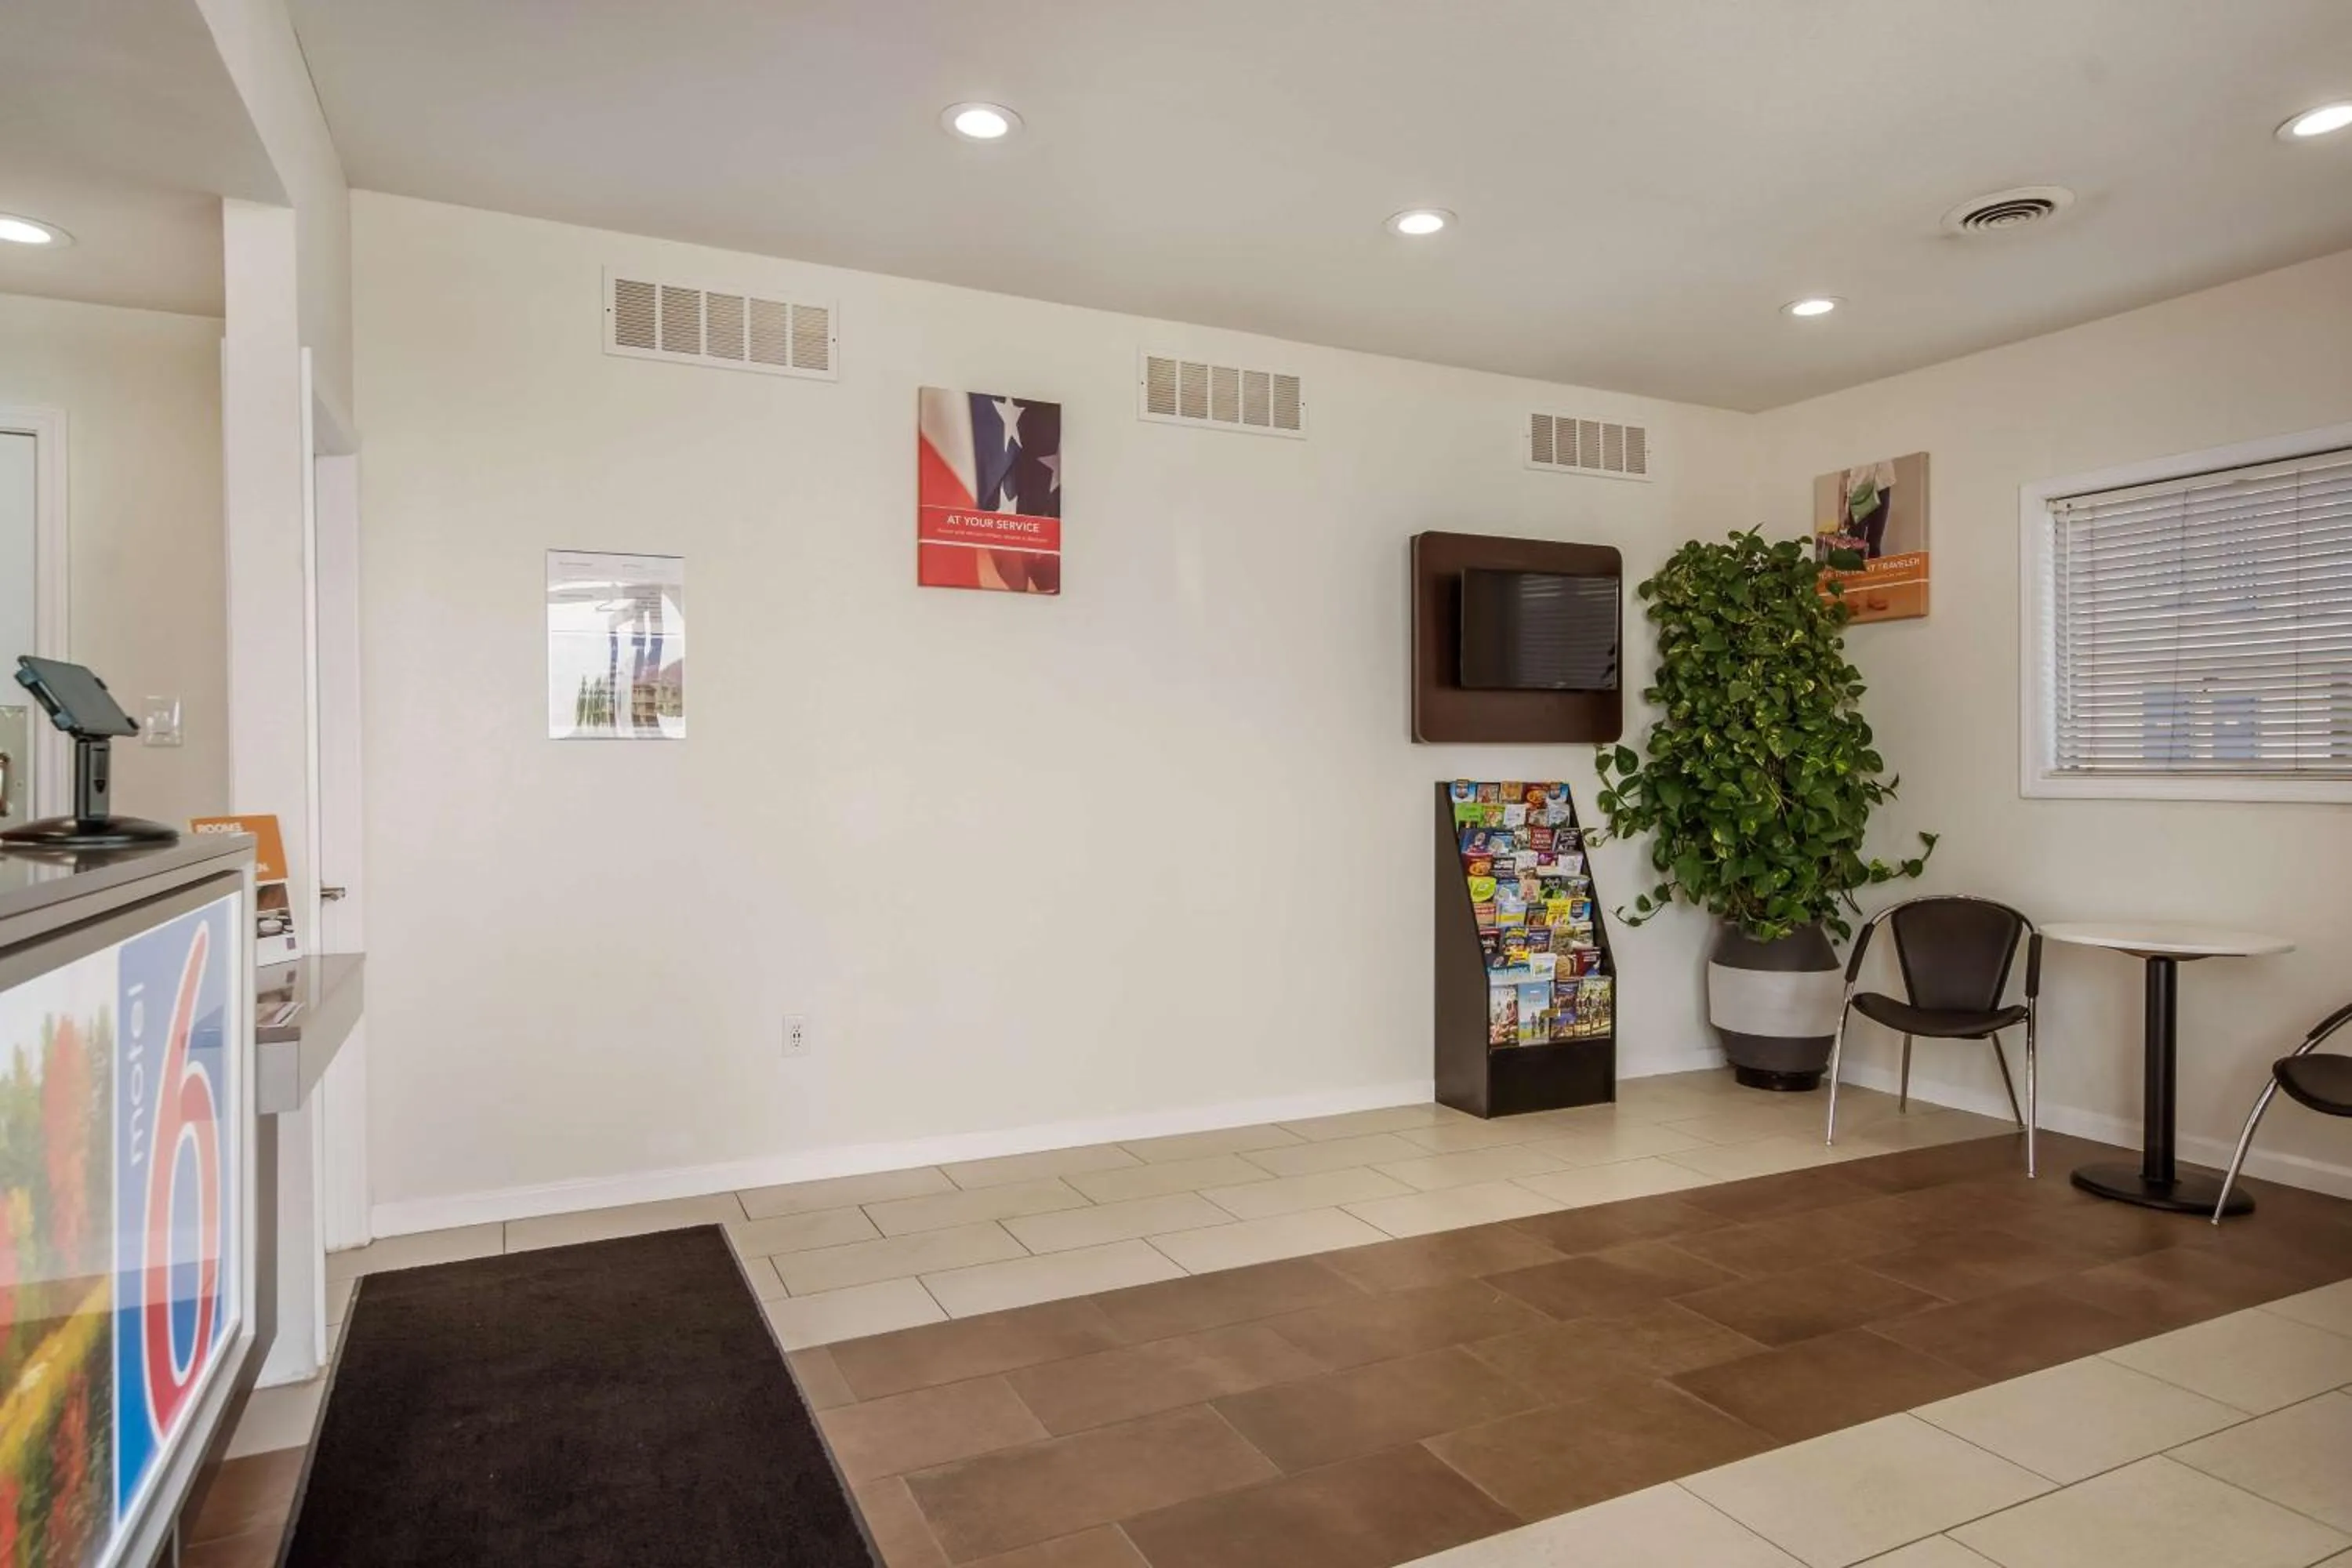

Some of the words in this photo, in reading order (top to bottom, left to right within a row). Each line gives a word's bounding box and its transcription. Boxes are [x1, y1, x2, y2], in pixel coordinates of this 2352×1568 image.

[946, 514, 960, 524] AT
[964, 517, 993, 528] YOUR
[996, 519, 1040, 533] SERVICE
[127, 982, 145, 1167] motel
